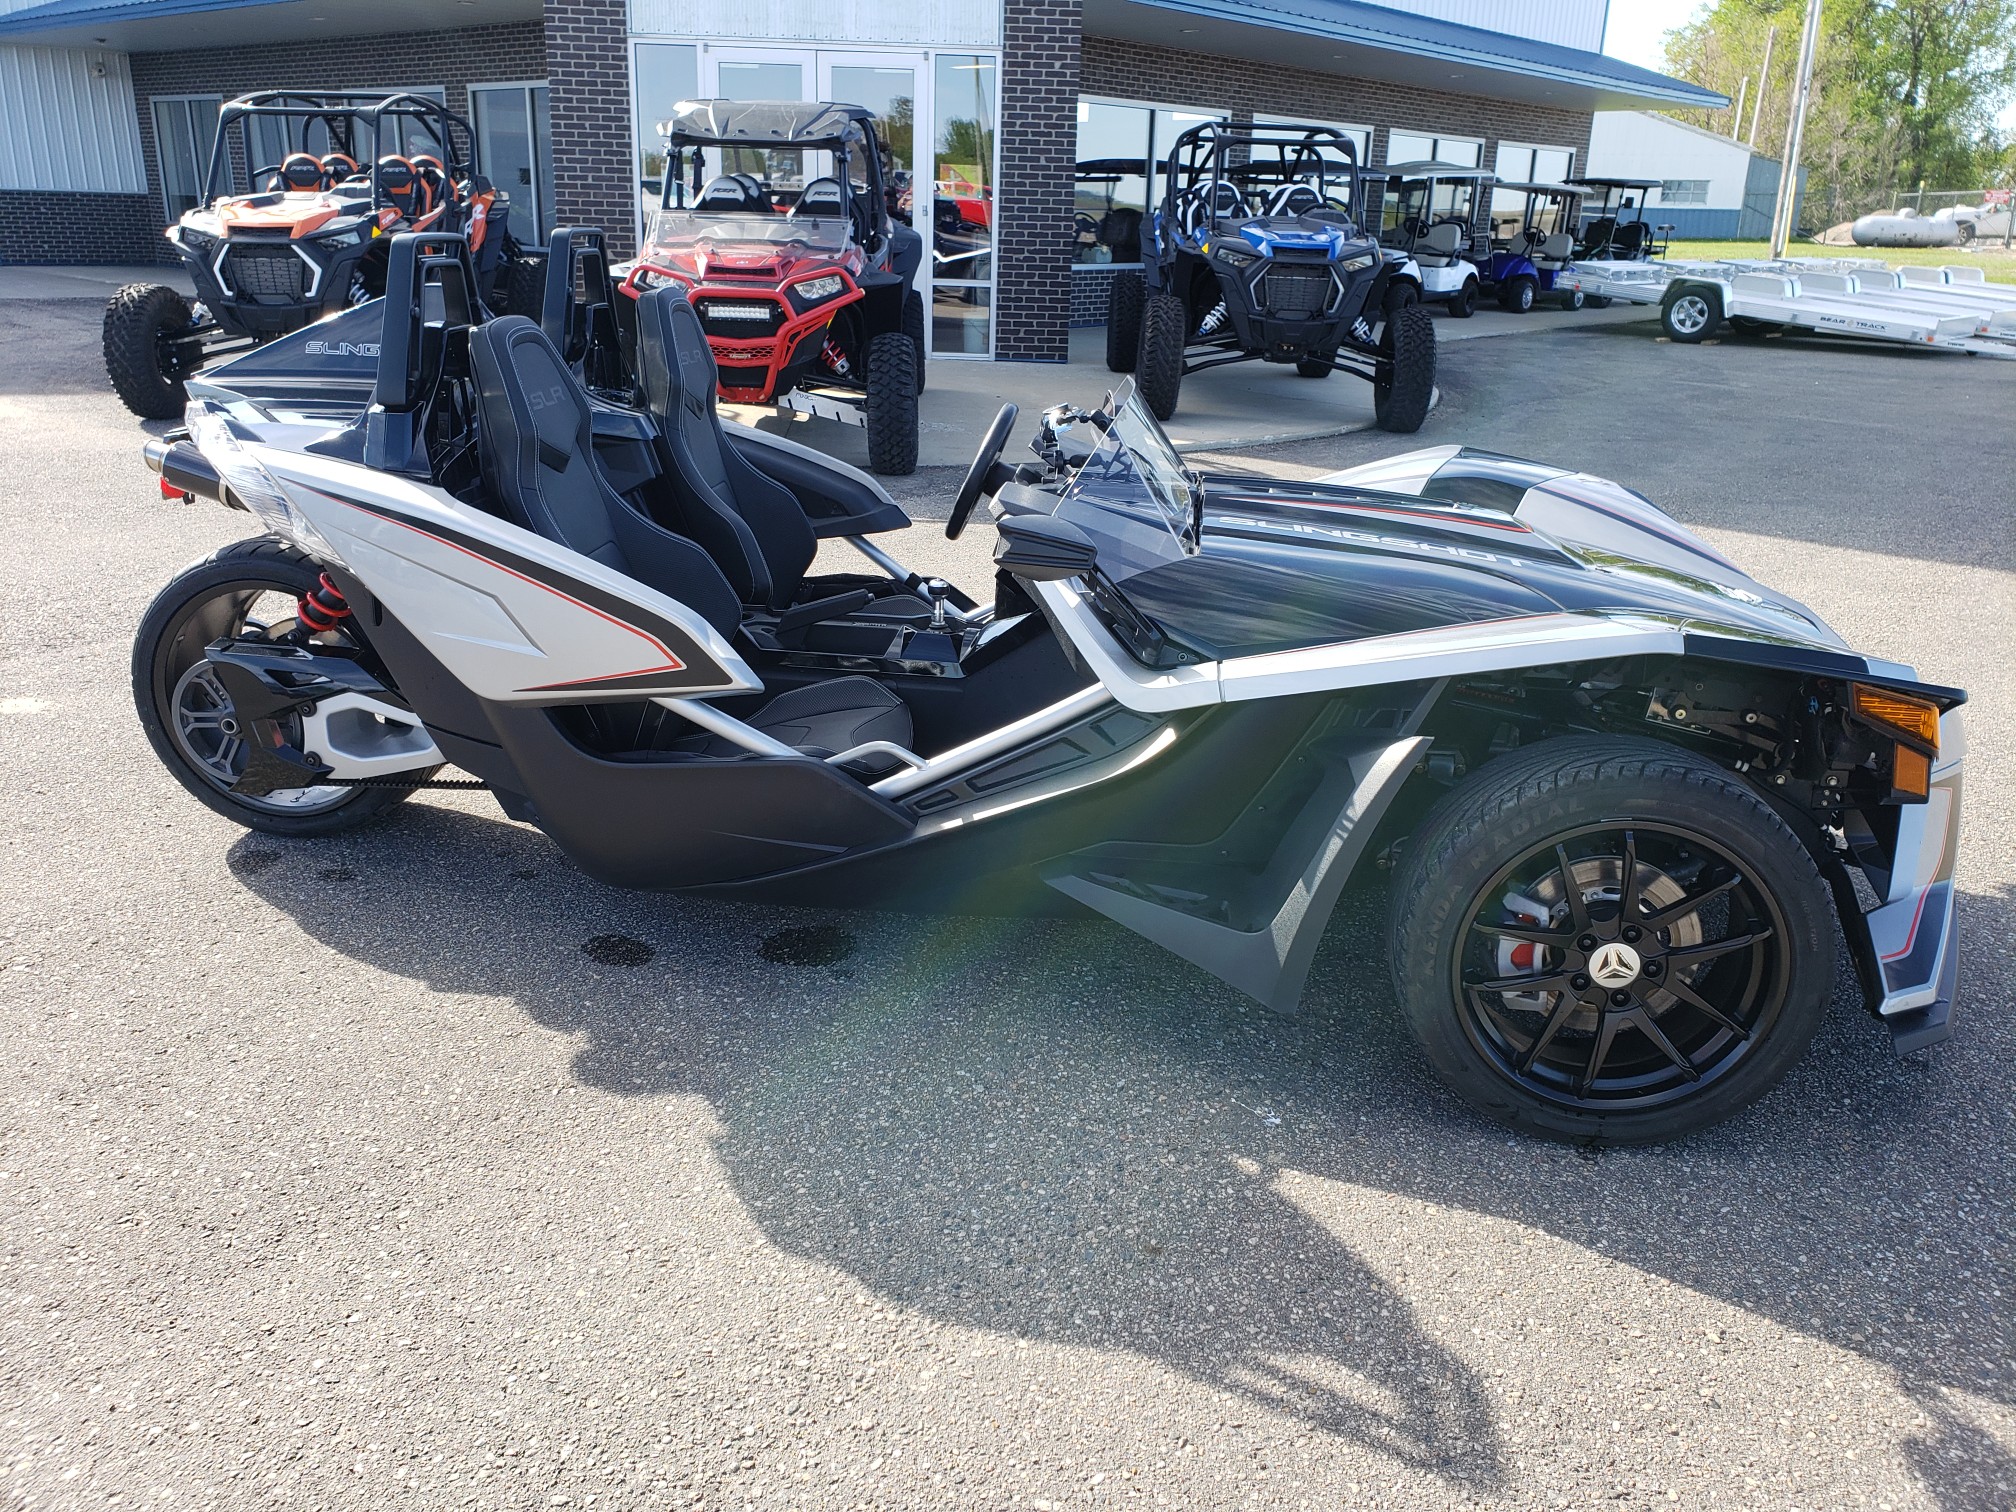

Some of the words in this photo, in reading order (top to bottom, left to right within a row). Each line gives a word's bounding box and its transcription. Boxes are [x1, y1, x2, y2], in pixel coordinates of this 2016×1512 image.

[1820, 316, 1846, 325] BEAR
[1856, 322, 1888, 330] TRACK
[680, 350, 705, 366] SLR
[529, 386, 566, 411] SLR
[1219, 516, 1527, 567] SLINGSHOT
[1421, 884, 1464, 977] KENDA
[1469, 798, 1586, 870] RADIAL
